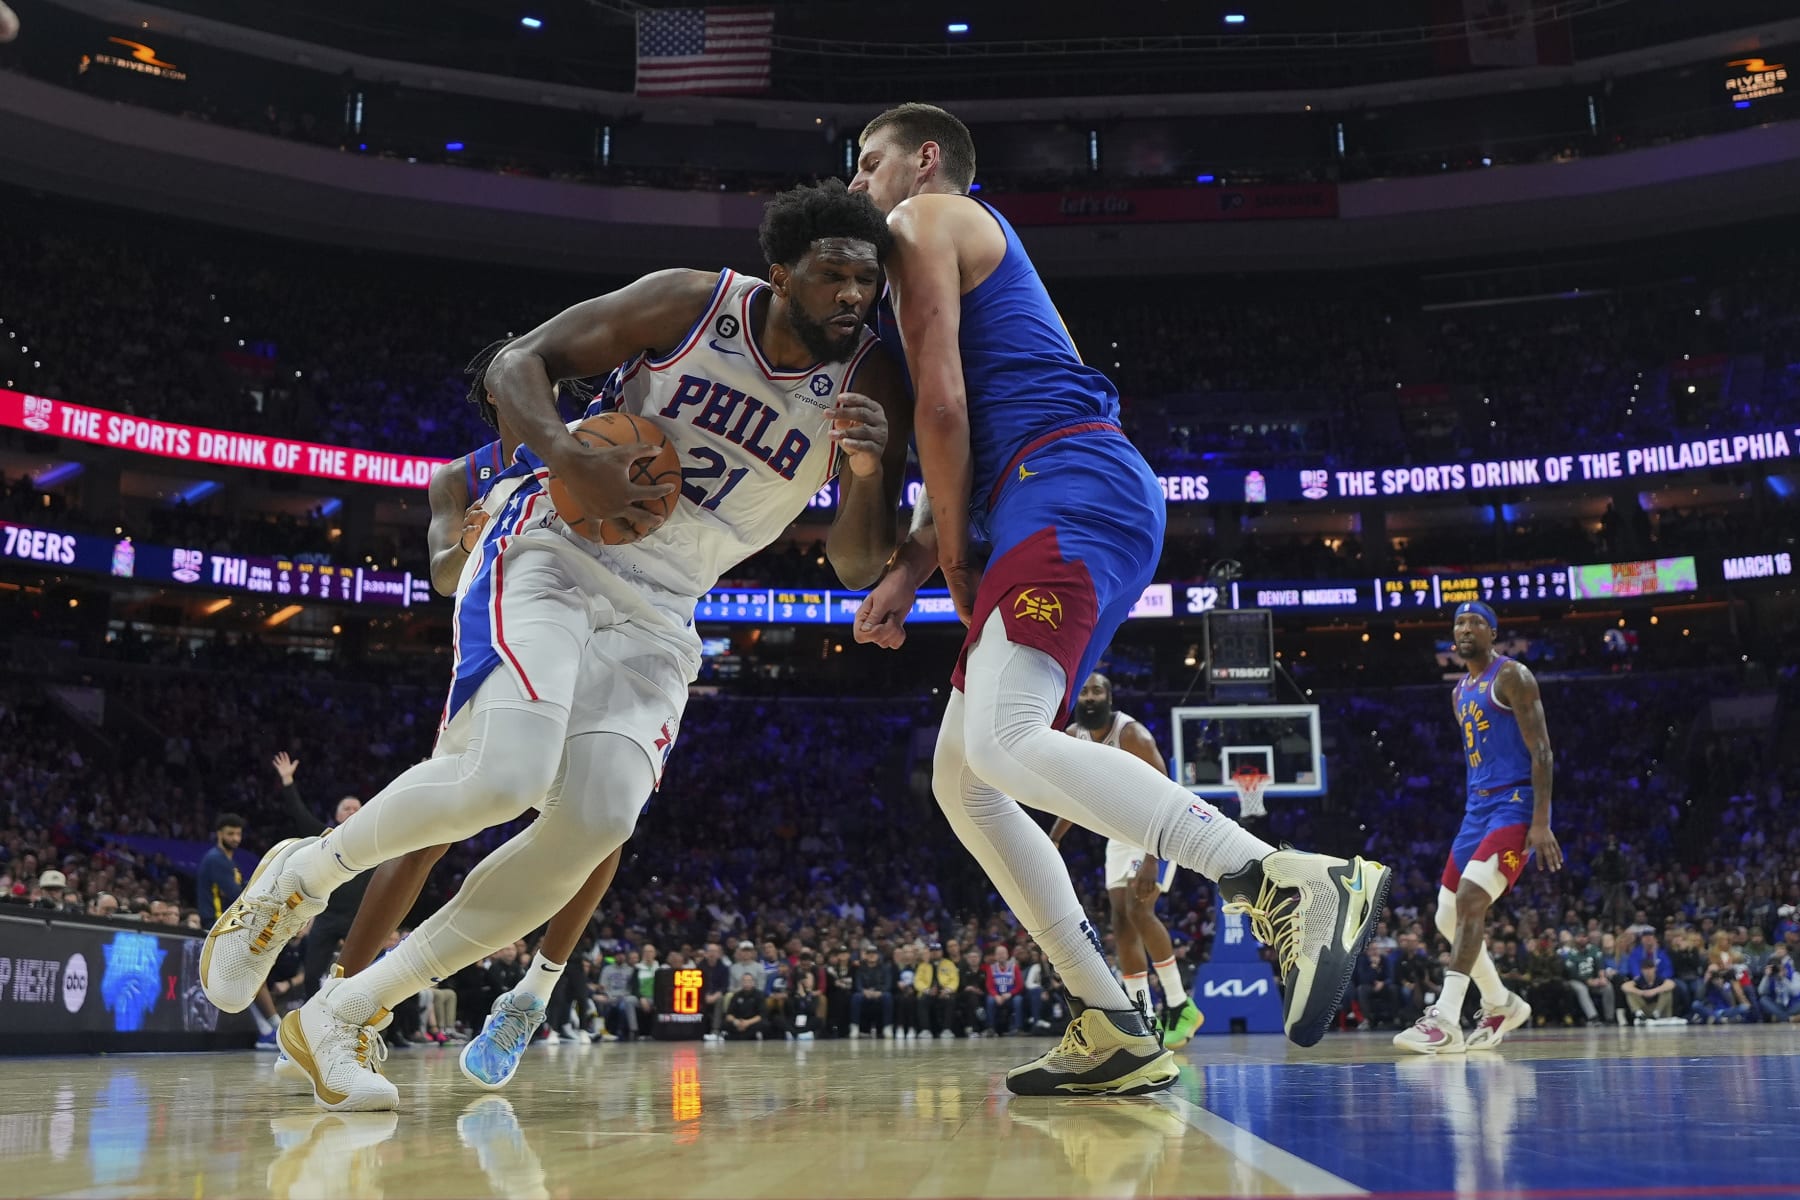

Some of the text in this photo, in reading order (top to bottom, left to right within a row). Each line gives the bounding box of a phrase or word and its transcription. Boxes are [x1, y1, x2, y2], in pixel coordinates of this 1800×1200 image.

[1726, 69, 1788, 90] RIVERS
[719, 318, 735, 336] 6
[660, 374, 811, 481] PHILA
[62, 407, 101, 439] THE
[107, 416, 191, 456] SPORTS
[198, 432, 267, 465] DRINK
[272, 442, 302, 469] OF
[308, 446, 347, 476] THE
[1336, 470, 1377, 496] THE
[1381, 465, 1465, 494] SPORTS
[1470, 458, 1540, 488] DRINK
[1545, 456, 1573, 482] OF
[1579, 452, 1621, 479] THE
[1627, 431, 1790, 475] PHILADELPHIA
[480, 468, 490, 480] 6
[681, 446, 749, 511] 21
[1157, 475, 1209, 500] ERS
[4, 526, 76, 565] 76ERS
[250, 566, 271, 580] PHI
[1723, 553, 1791, 580] MARCH 16
[247, 578, 273, 592] DEN
[277, 581, 291, 594] 10
[386, 581, 403, 595] PM
[1385, 580, 1404, 592] FLS
[1441, 577, 1478, 591] PLAYER
[1552, 572, 1566, 585] 32
[1144, 595, 1163, 606] 1ST
[1186, 586, 1218, 614] 32
[1257, 588, 1357, 606] DENVER NUGGETS
[1390, 590, 1426, 607] 3 7
[1442, 590, 1479, 603] POINTS
[1555, 585, 1565, 597] 0
[782, 603, 817, 618] 3 6
[1229, 667, 1270, 679] TISSOT
[1465, 721, 1474, 748] 5
[13, 957, 61, 1003] NEXT
[1204, 979, 1268, 997] KIA
[674, 987, 699, 1013] 10
